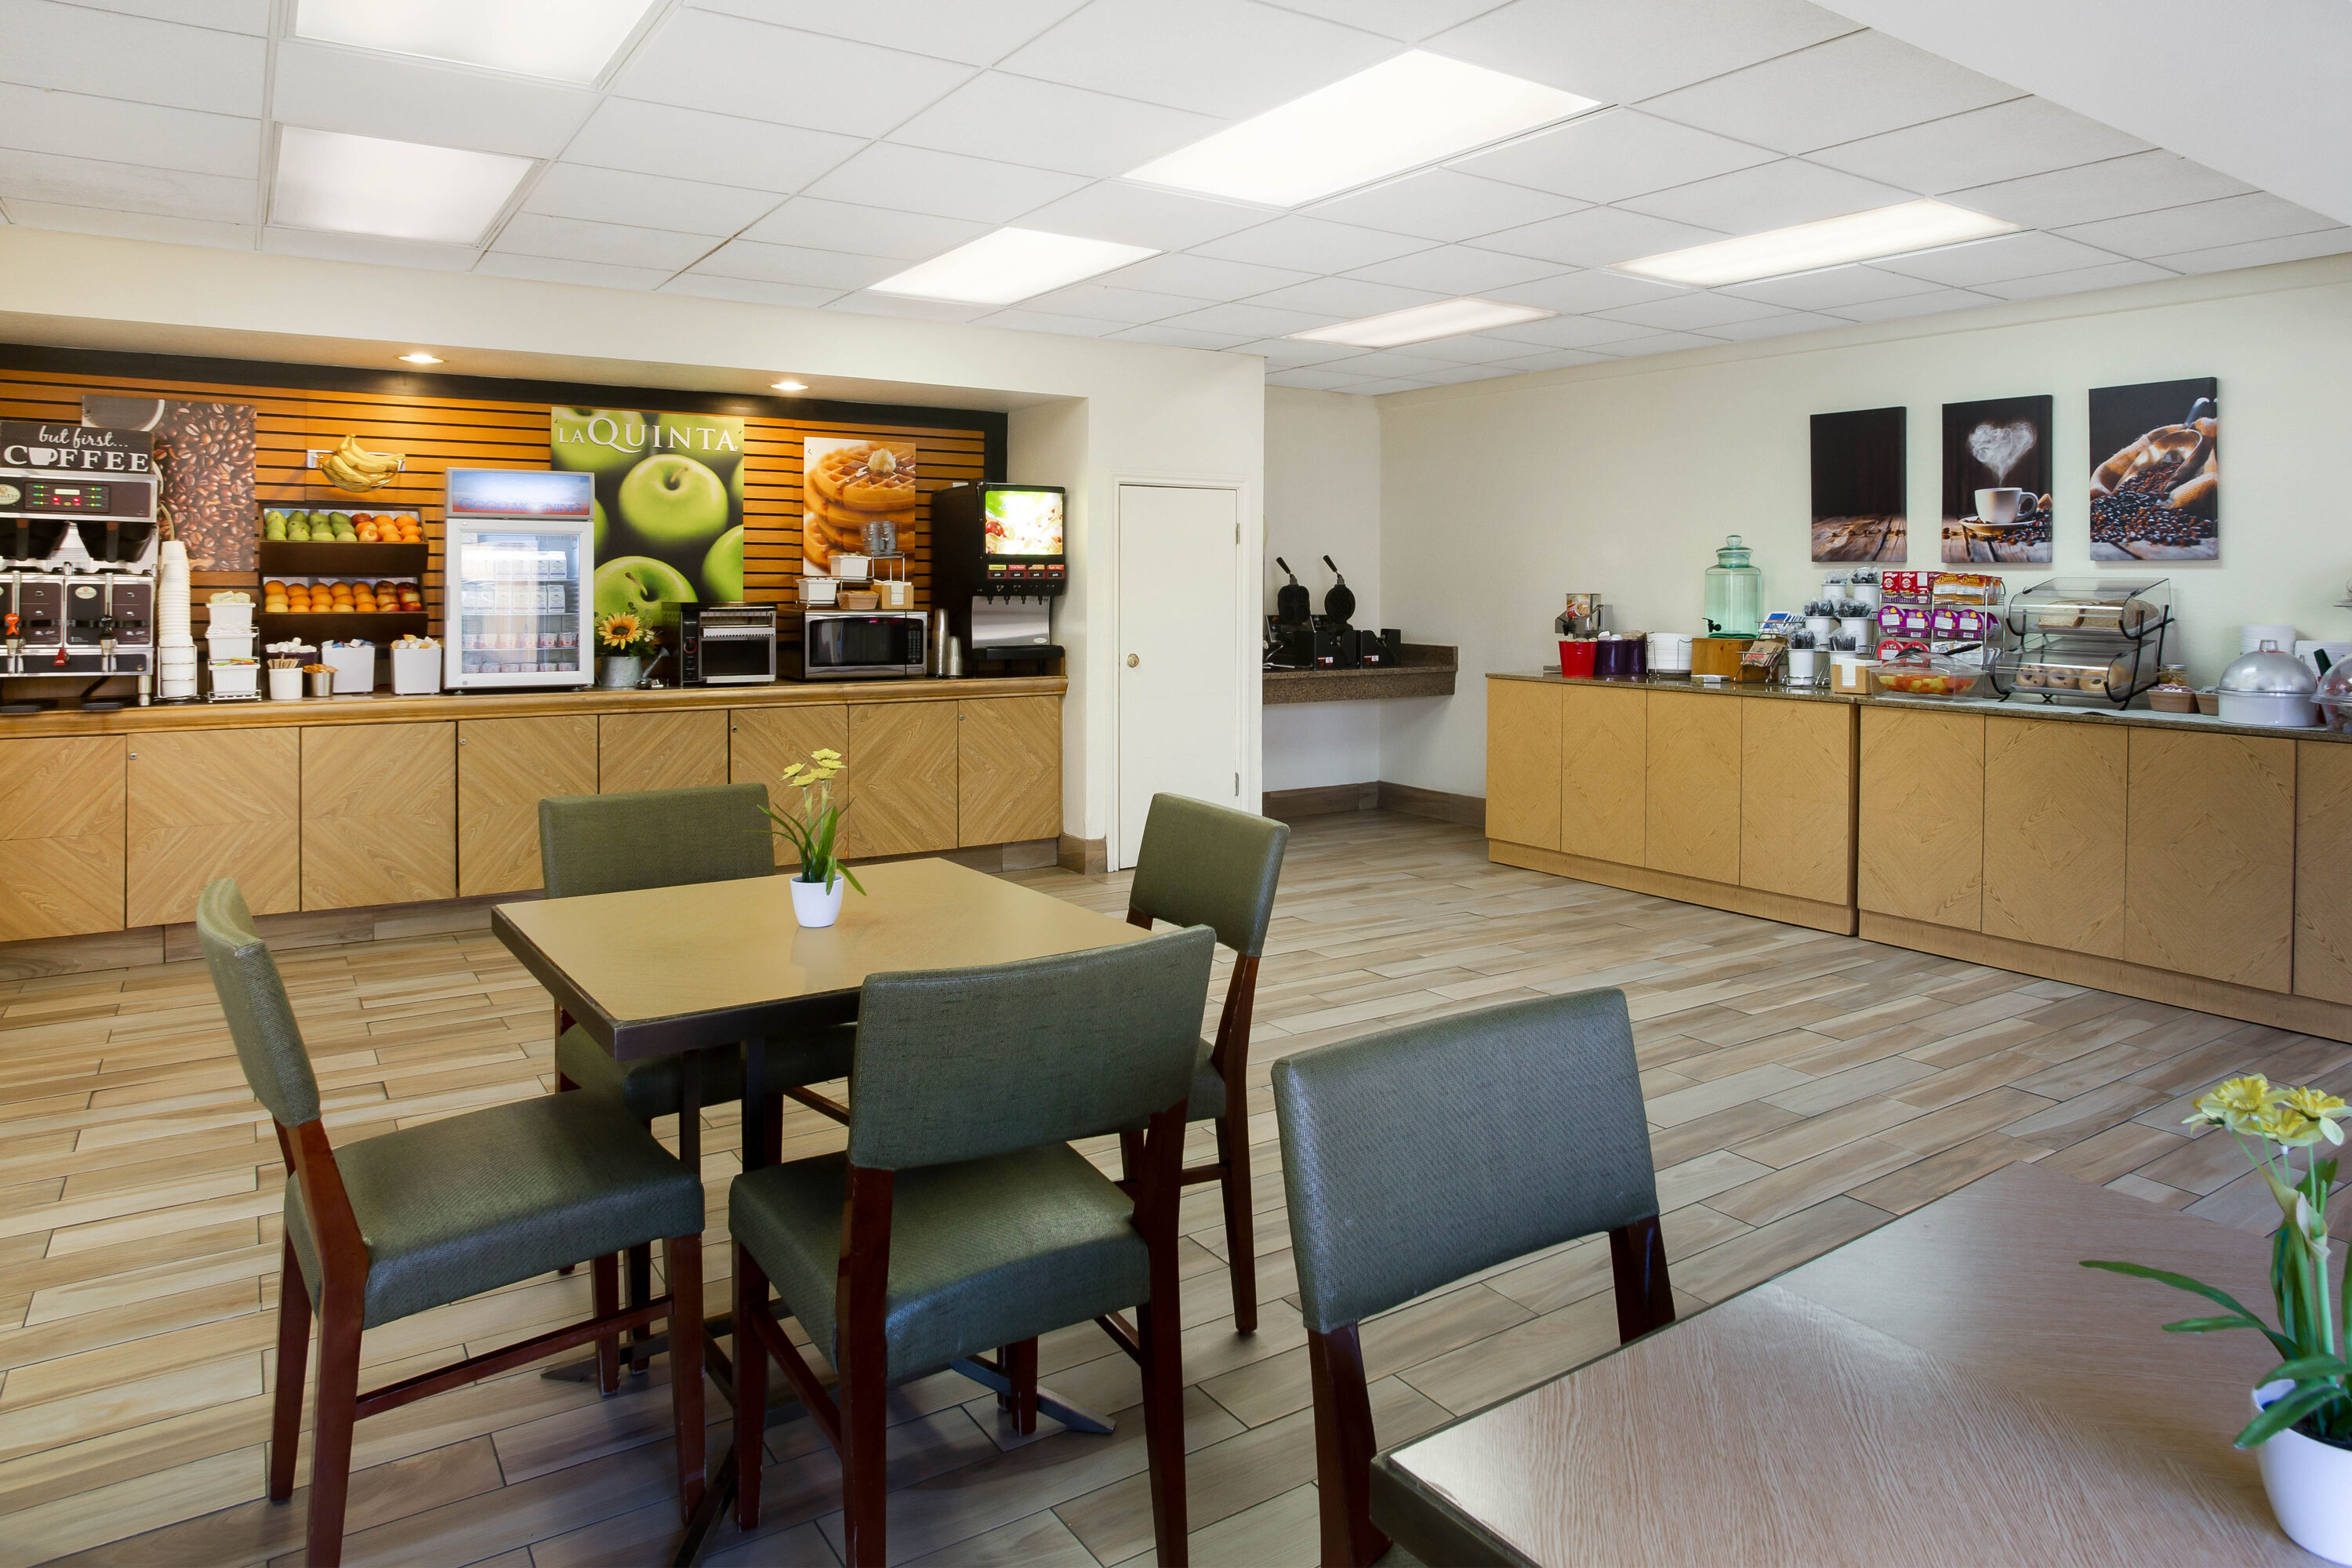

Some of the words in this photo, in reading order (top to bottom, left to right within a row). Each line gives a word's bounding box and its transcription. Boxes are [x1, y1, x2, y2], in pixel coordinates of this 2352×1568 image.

[39, 425, 71, 444] but
[73, 427, 129, 448] first...
[559, 427, 585, 444] LA
[588, 417, 738, 454] QUINTA
